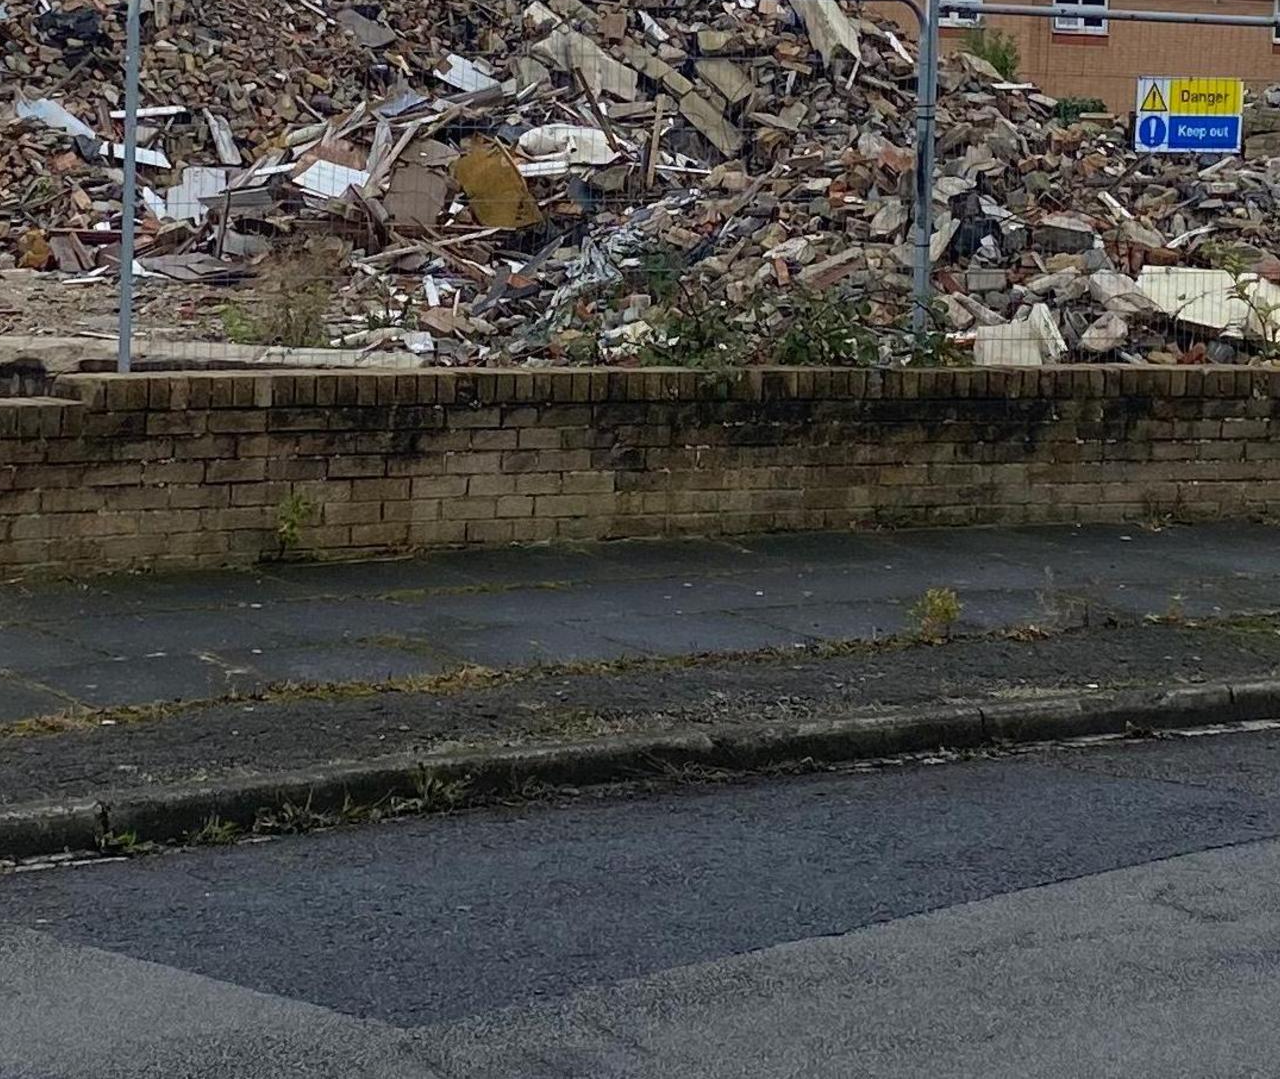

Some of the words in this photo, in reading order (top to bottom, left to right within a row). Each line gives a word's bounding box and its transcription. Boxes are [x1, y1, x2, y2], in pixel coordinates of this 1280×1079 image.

[1181, 90, 1230, 106] Danger
[1178, 124, 1207, 140] Keep
[1209, 126, 1229, 138] out
